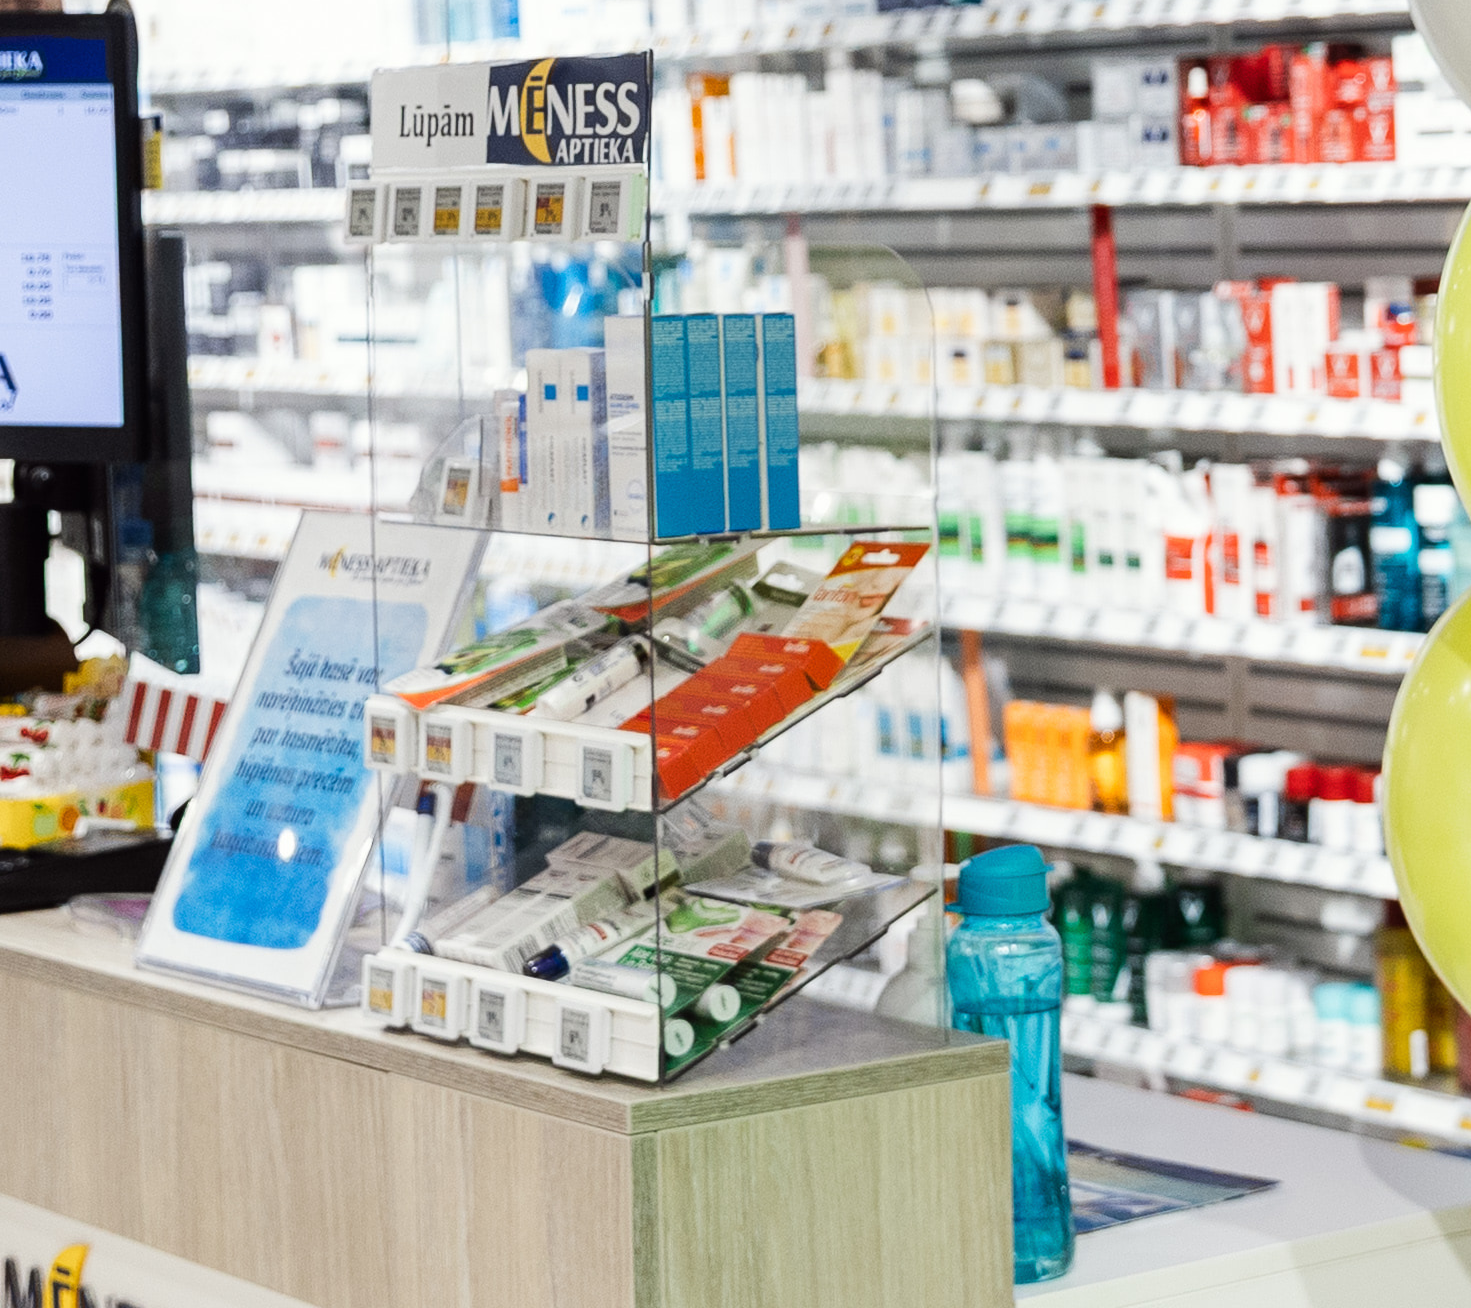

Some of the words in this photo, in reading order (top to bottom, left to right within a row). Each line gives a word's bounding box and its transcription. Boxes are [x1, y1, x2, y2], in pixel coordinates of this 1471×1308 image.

[399, 104, 475, 148] Lūpām
[486, 76, 640, 137] MĒNESS
[555, 137, 637, 164] APTIEKA
